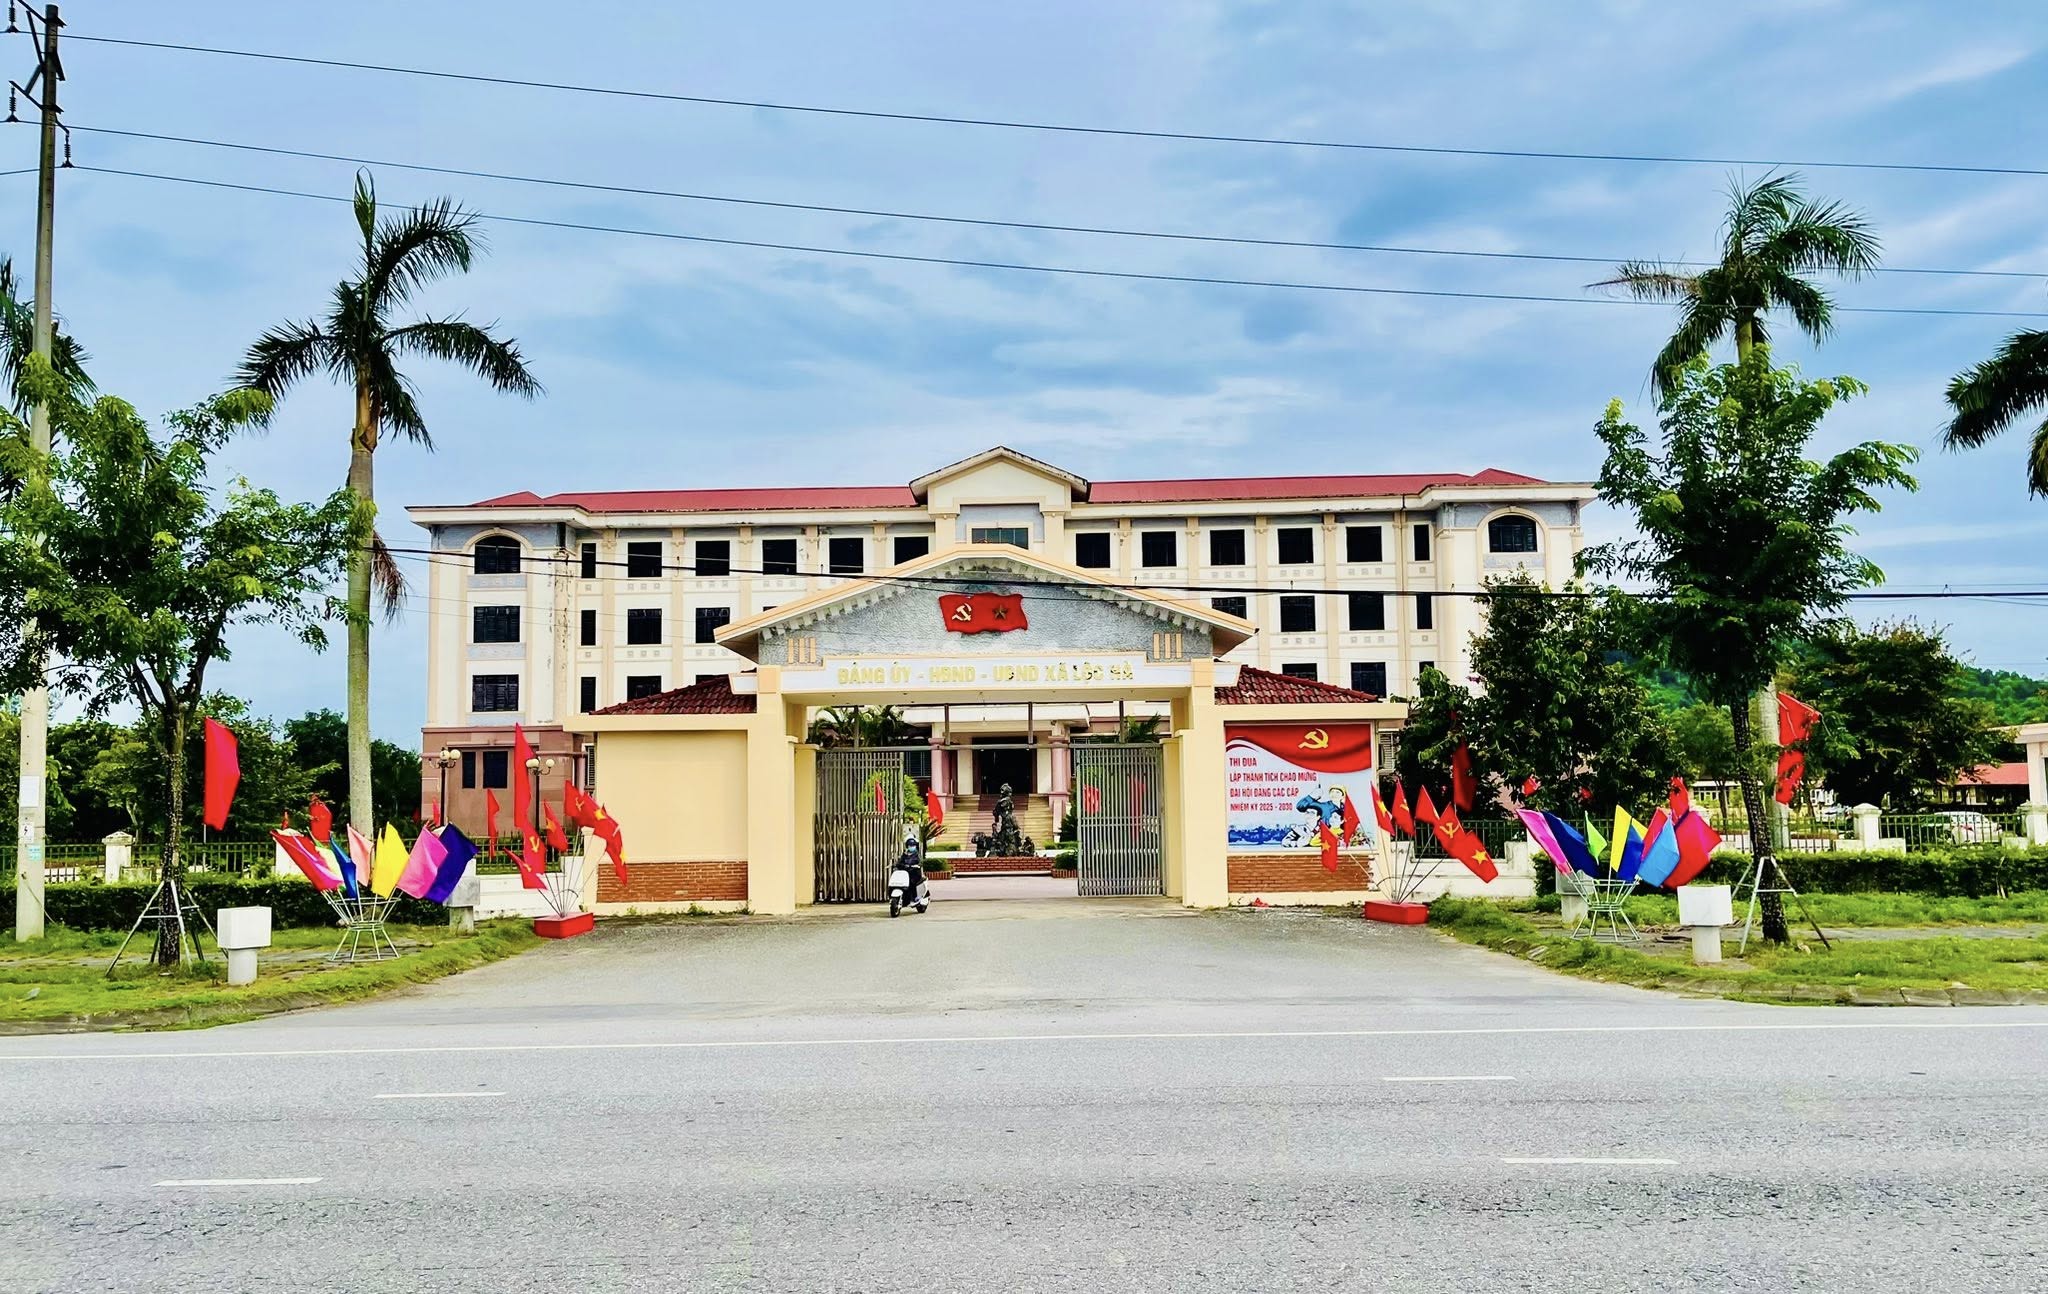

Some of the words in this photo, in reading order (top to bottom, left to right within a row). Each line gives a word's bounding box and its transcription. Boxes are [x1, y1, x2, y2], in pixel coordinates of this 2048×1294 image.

[1229, 757, 1241, 767] THI
[1260, 803, 1274, 811] 2025
[1279, 803, 1293, 811] 2030
